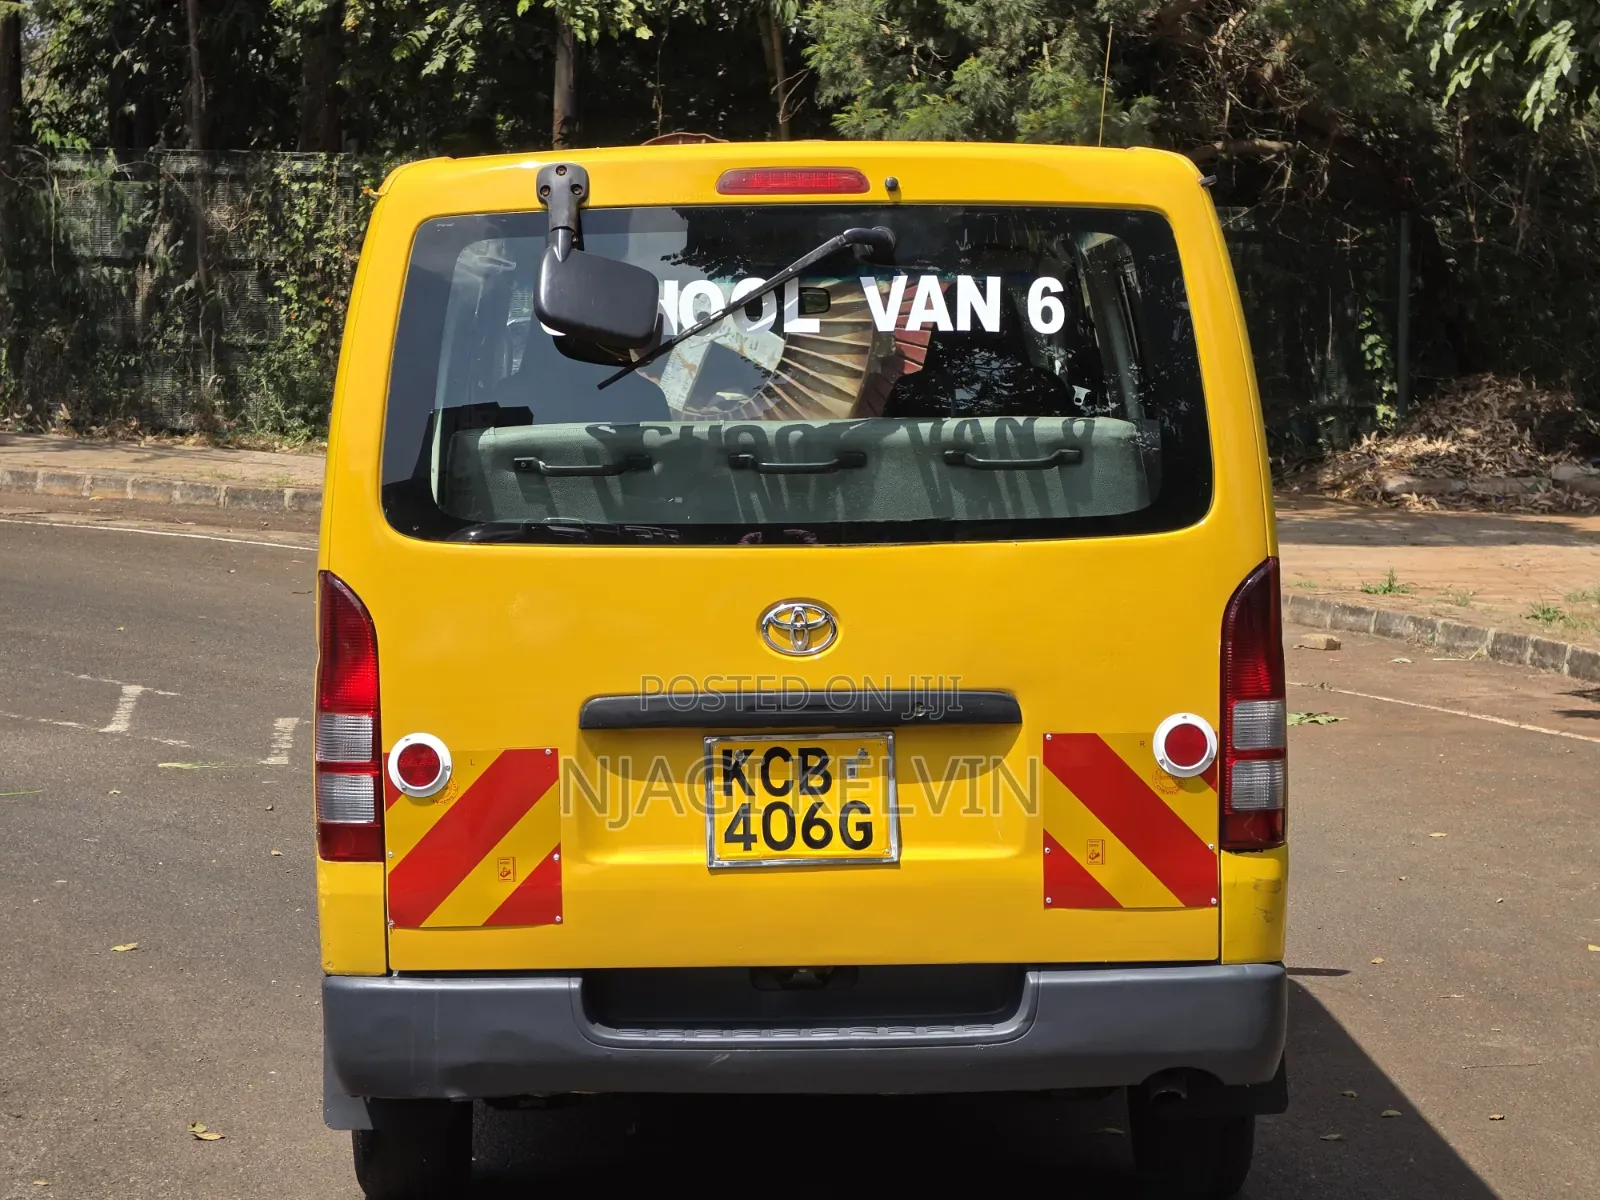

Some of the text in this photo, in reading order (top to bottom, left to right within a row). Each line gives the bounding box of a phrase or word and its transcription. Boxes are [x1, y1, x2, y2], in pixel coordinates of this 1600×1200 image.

[860, 275, 1001, 332] VAN
[1027, 276, 1066, 335] 6
[722, 746, 833, 798] KCB
[724, 799, 874, 852] 406G
